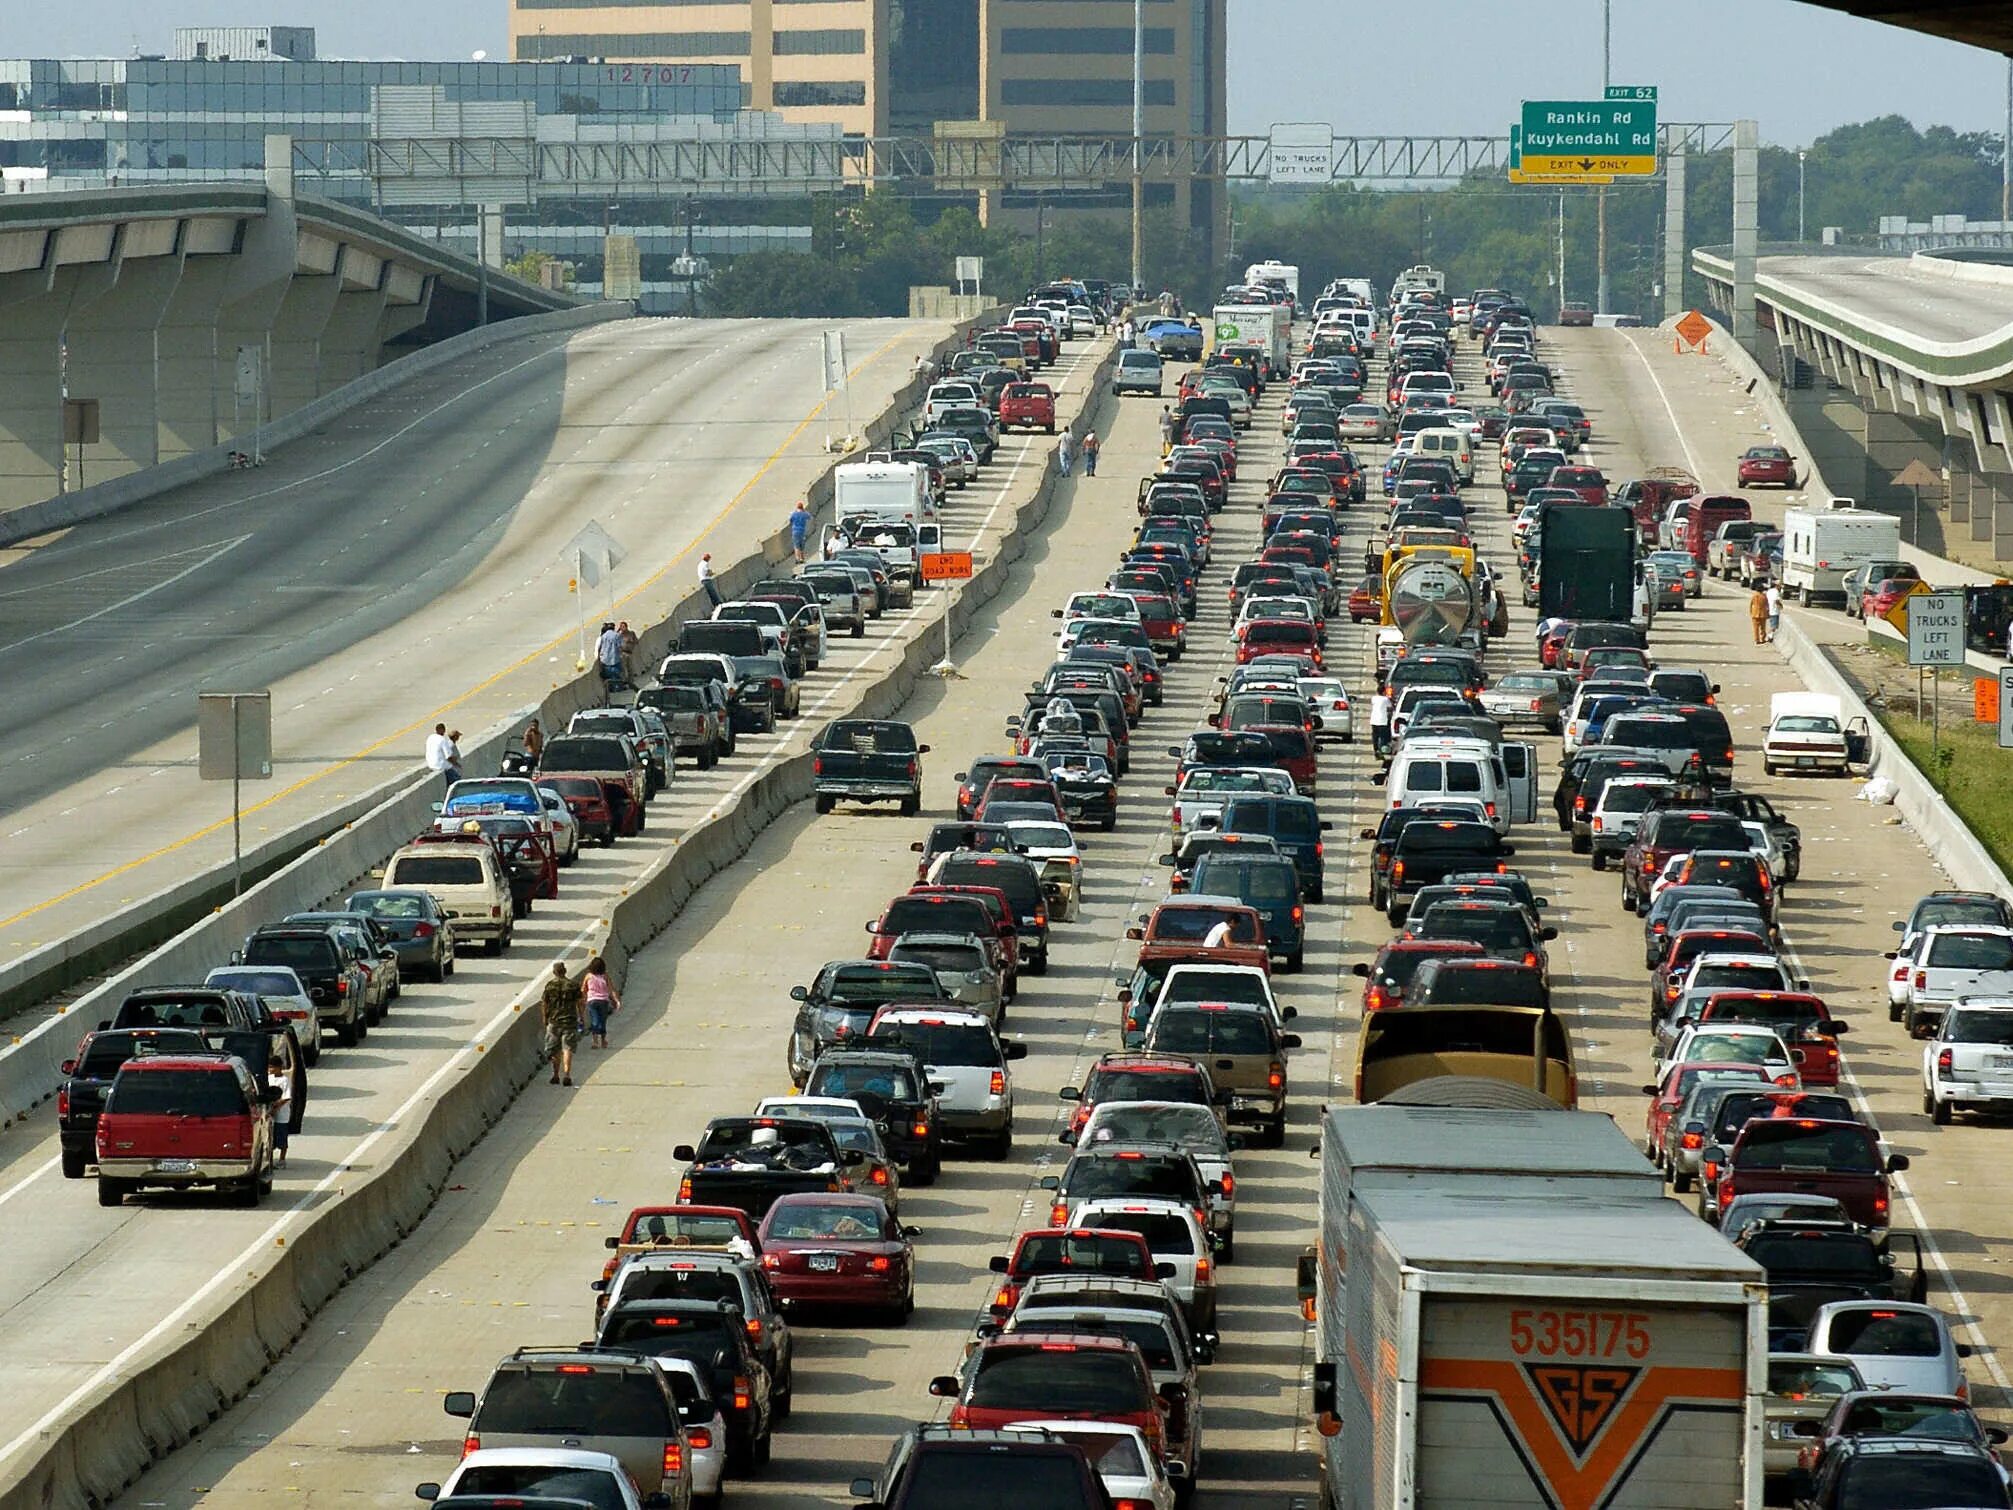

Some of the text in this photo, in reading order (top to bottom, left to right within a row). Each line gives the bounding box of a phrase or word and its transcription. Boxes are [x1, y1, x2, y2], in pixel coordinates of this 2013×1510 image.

[606, 67, 691, 83] 12707
[1609, 87, 1652, 98] EXIT 62
[1547, 111, 1632, 124] Rankin Rd
[1527, 133, 1650, 147] Kuykendahl Rd
[1550, 160, 1629, 169] EXIT ONLY
[1927, 599, 1945, 610] NO
[1916, 615, 1958, 627] TRUCKS
[1923, 632, 1949, 644] LEFT
[1922, 649, 1951, 661] LANE
[1511, 1310, 1650, 1359] 535175
